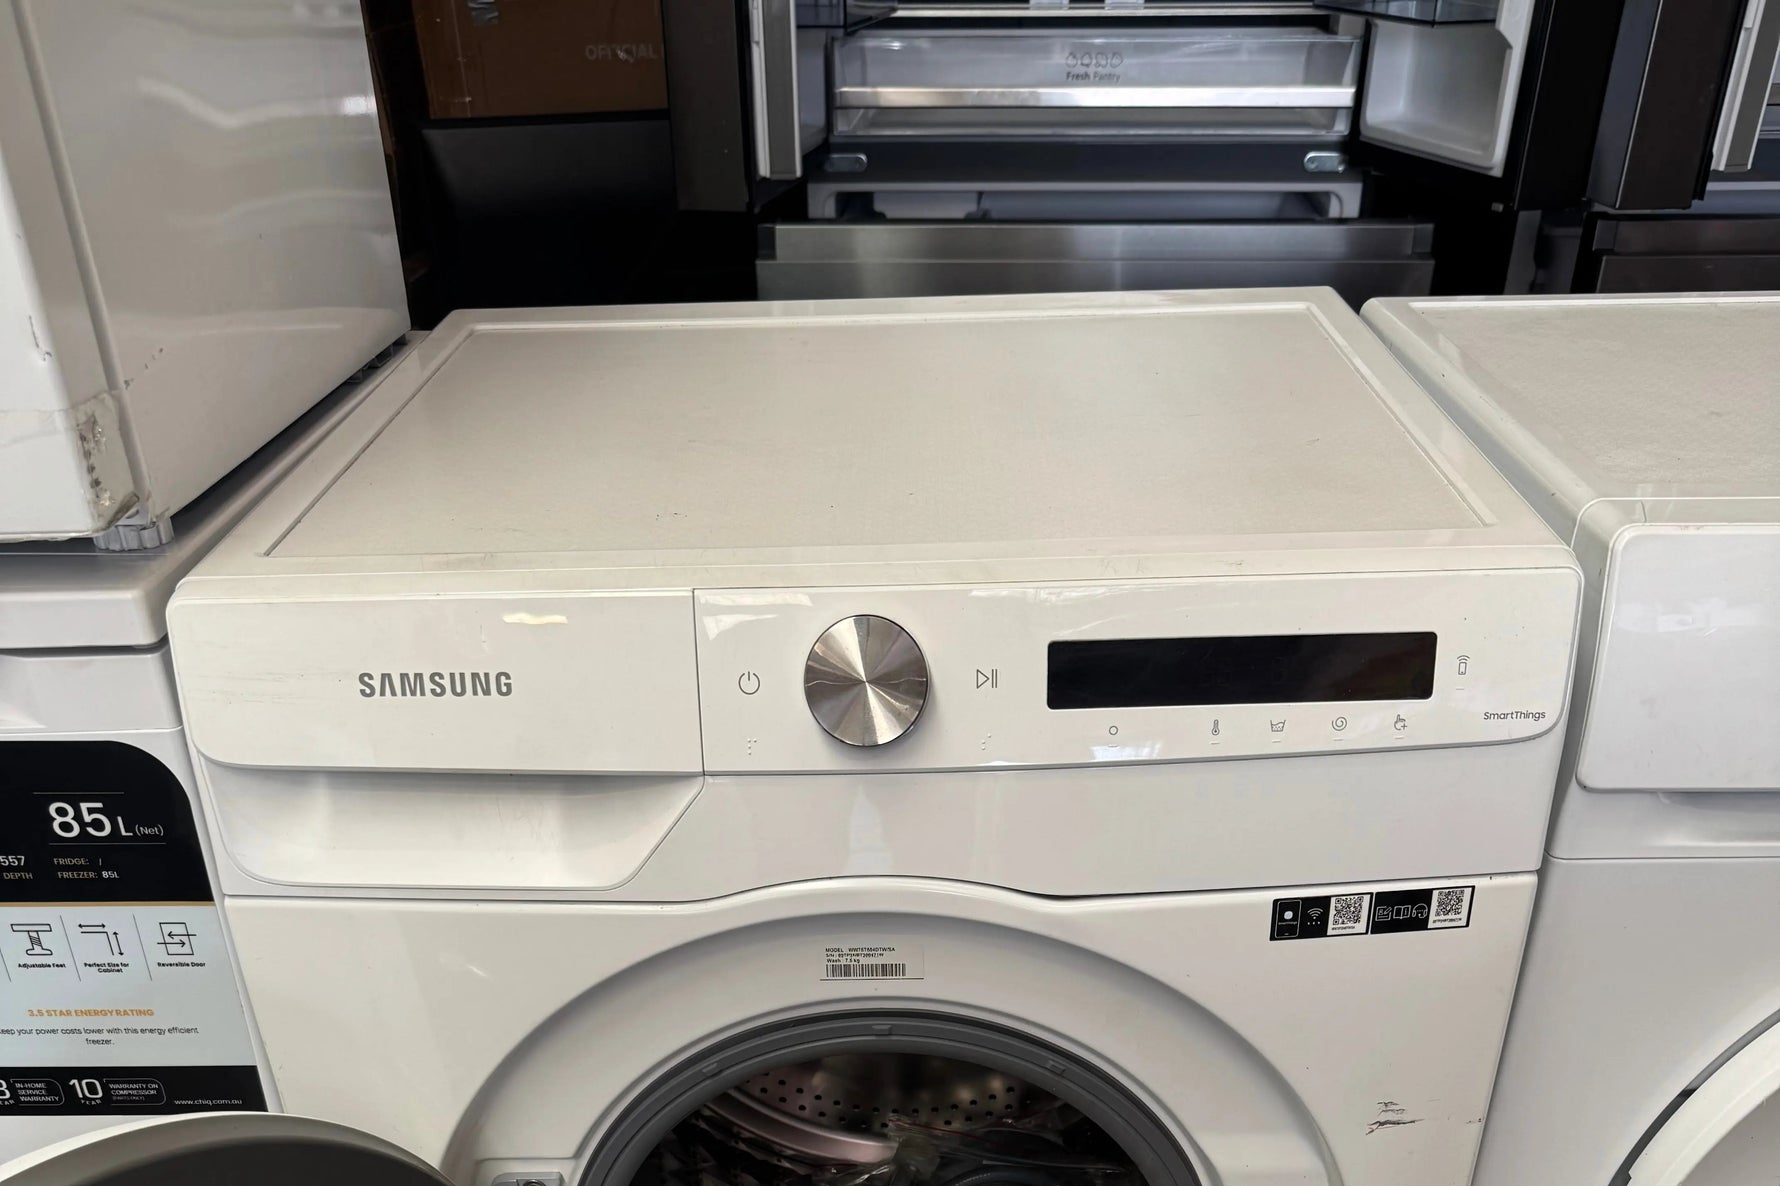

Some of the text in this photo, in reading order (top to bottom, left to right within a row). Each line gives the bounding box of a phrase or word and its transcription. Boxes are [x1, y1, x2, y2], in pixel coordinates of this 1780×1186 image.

[1066, 71, 1121, 82] Fresh Pantry
[358, 671, 512, 698] SAMSUNG
[1483, 710, 1546, 722] SmartThings
[48, 801, 164, 838] 85 L (Net)
[0, 855, 26, 866] 557
[53, 857, 90, 865] FRIDGE:
[3, 872, 34, 880] DEPTH
[58, 871, 120, 879] FREEZER: 85L
[28, 1009, 155, 1017] 3.5 STAR ENERGY RATING
[69, 1079, 103, 1099] 10
